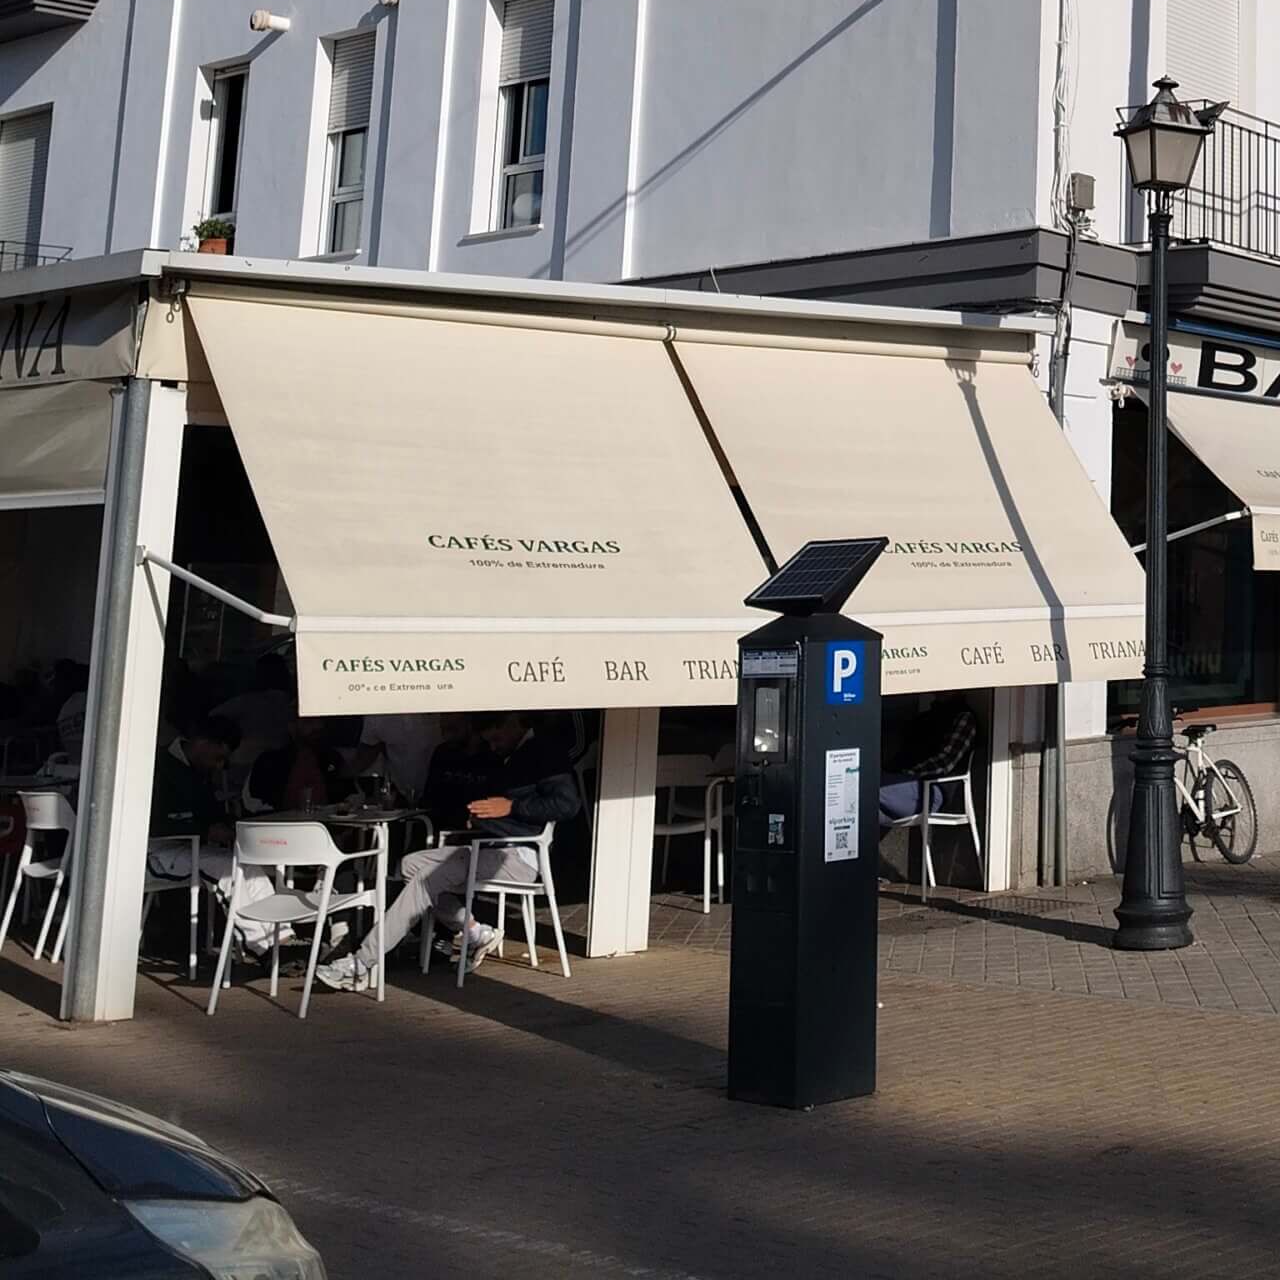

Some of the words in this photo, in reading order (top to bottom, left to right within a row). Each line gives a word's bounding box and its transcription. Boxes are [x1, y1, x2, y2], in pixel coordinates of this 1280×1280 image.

[427, 534, 513, 552] CAFÉS
[517, 538, 621, 554] VARGAS
[946, 541, 1024, 553] VARGAS
[469, 559, 503, 568] 100%
[507, 560, 522, 569] de
[526, 560, 605, 570] Extremadura
[882, 646, 929, 660] ARGAS
[960, 642, 1005, 666] CAFÉ
[1030, 644, 1065, 662] BAR
[389, 658, 465, 672] VARGAS
[508, 656, 566, 683] CAFÉ
[604, 660, 649, 681] BAR
[832, 649, 857, 693] P
